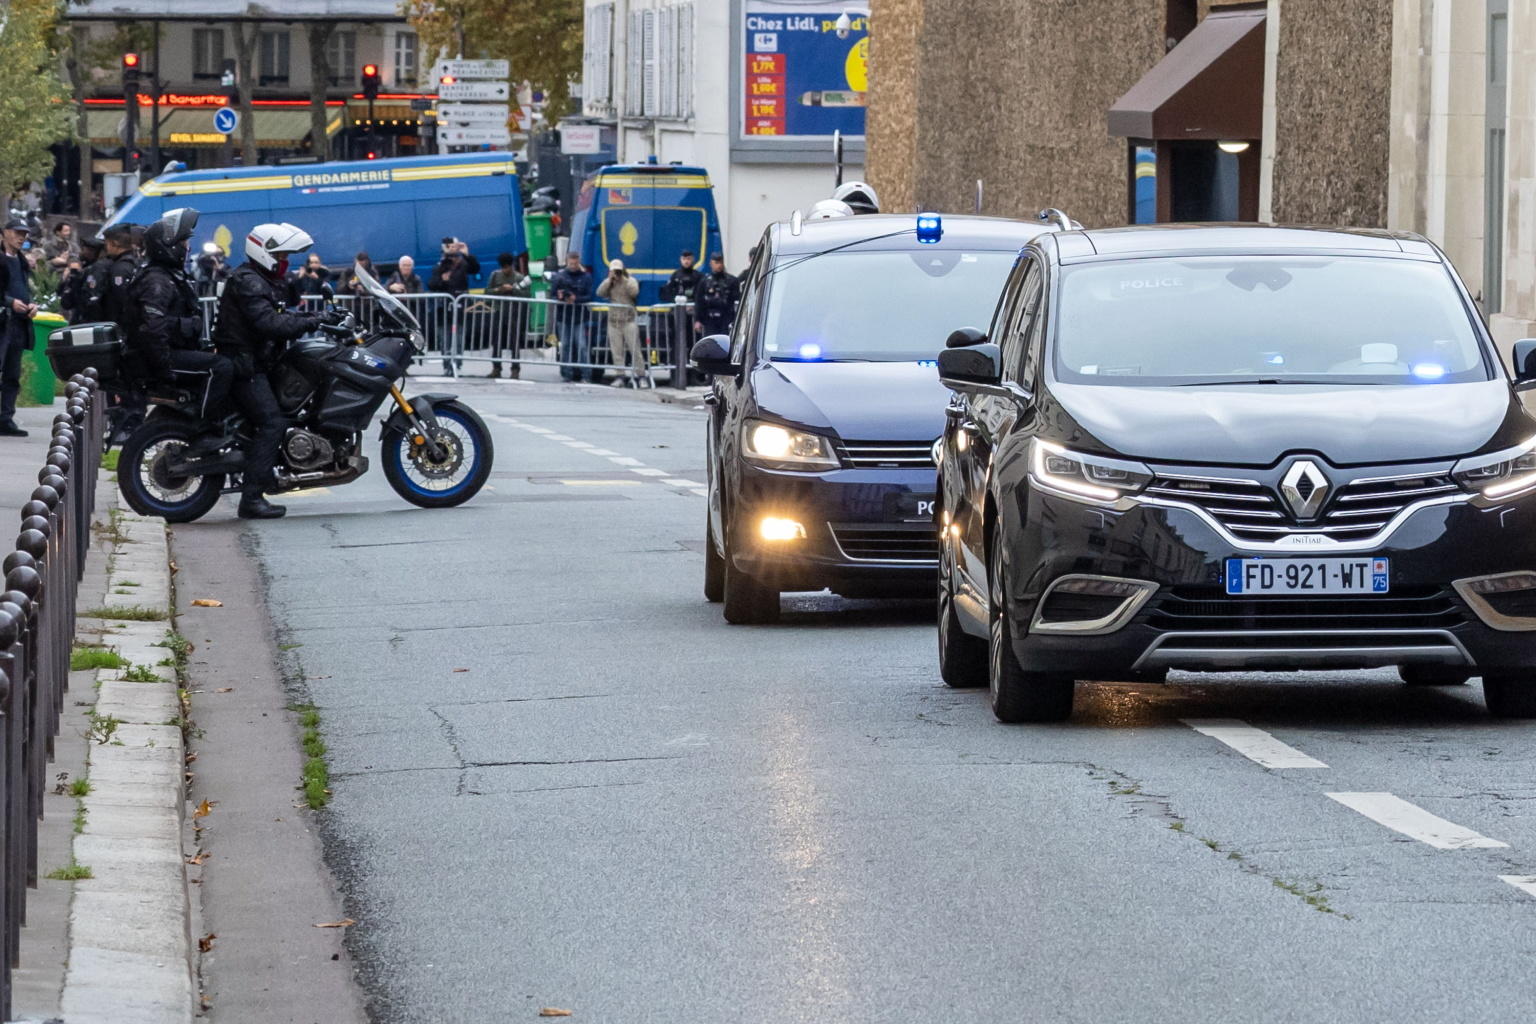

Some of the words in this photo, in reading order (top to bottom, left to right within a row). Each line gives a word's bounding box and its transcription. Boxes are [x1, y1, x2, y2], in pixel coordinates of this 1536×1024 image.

[747, 17, 783, 30] Chez
[786, 17, 819, 32] Lidl,
[294, 169, 390, 187] GENDARMERIE
[1119, 277, 1184, 290] POLICE
[1232, 578, 1238, 587] F
[1245, 563, 1369, 590] FD-921-WT
[1373, 576, 1387, 588] 75
